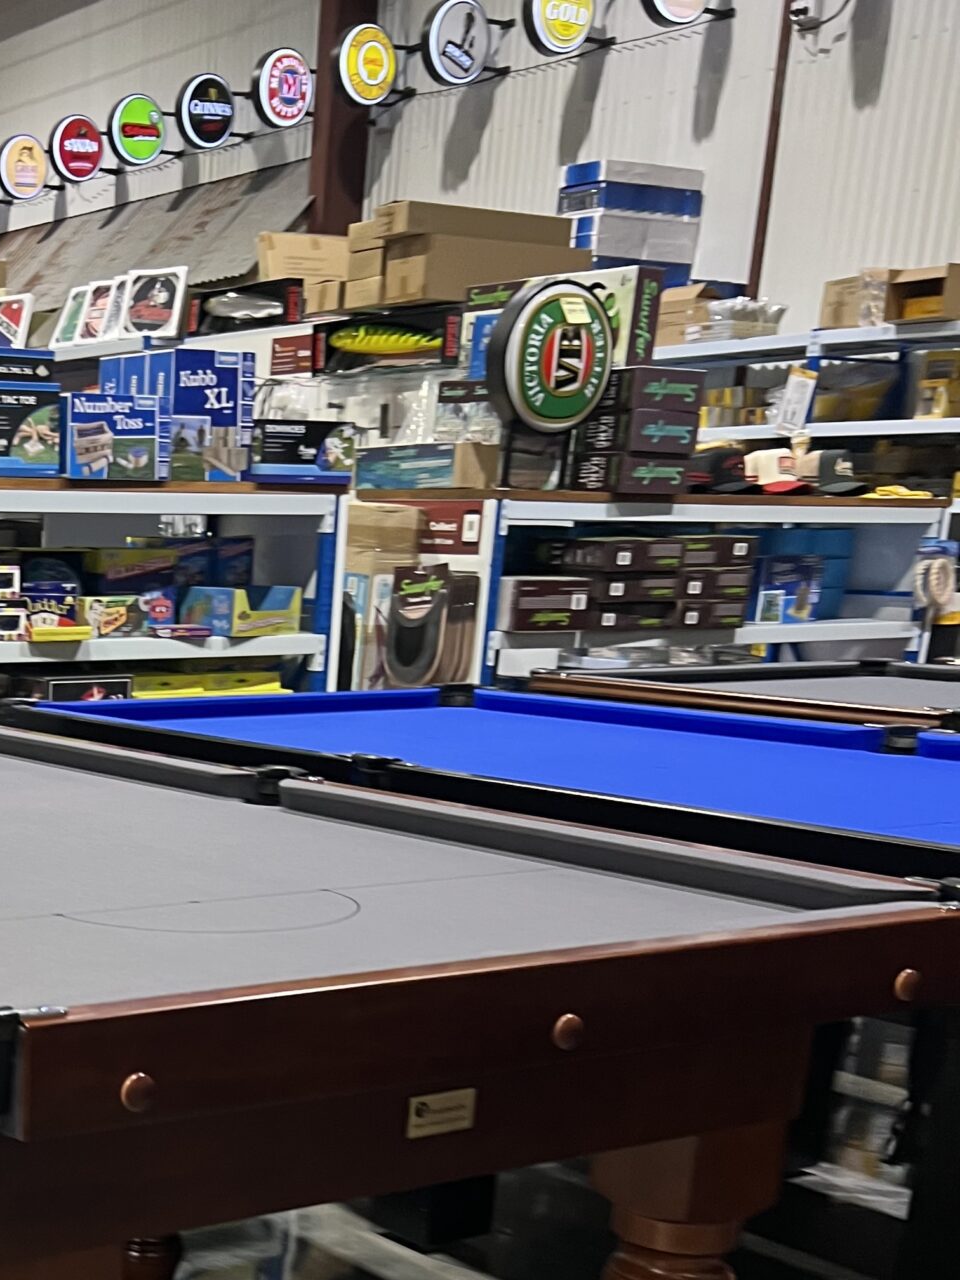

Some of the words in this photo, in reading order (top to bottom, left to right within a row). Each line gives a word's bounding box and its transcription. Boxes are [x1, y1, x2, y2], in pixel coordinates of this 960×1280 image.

[546, 1, 589, 25] GOLD
[523, 313, 554, 407] VICTORIA
[553, 327, 583, 391] VB
[178, 369, 218, 387] Kubb
[73, 396, 134, 414] Number
[203, 388, 234, 409] XL
[112, 415, 144, 430] Toss
